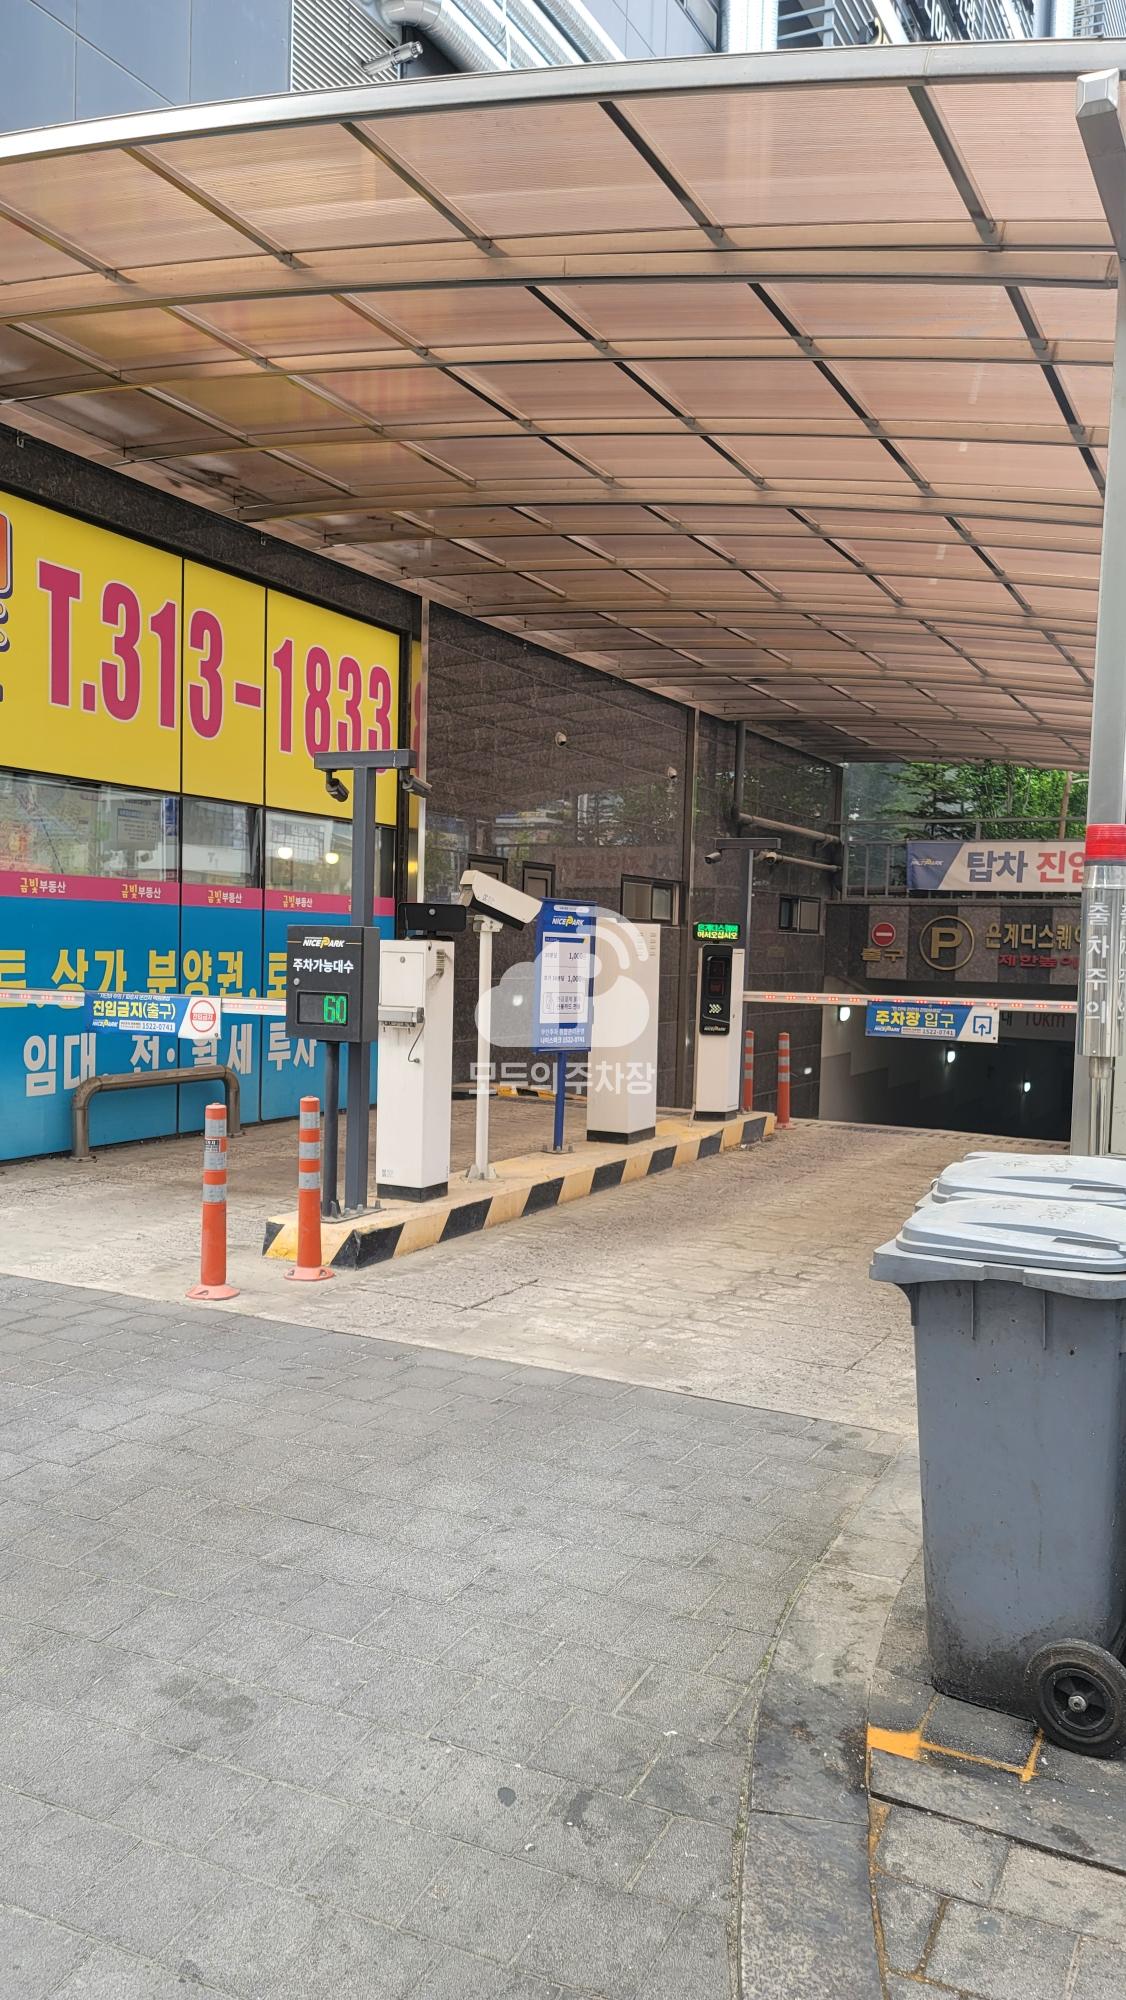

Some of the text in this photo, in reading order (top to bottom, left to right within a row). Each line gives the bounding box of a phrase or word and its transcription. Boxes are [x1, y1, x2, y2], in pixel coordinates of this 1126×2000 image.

[37, 558, 393, 774] T.313-1833
[967, 849, 1029, 884] 탑차
[20, 877, 66, 894] 금빛부동산
[121, 884, 162, 899] 금빛부동산
[207, 890, 242, 905] 금빛부동산
[283, 895, 313, 909] 금빛부동산
[552, 915, 585, 927] NICEPARK
[302, 936, 345, 949] NICEPARK
[697, 931, 739, 940] 어서오십시오
[930, 926, 963, 960] P
[292, 957, 355, 974] 주차가능대수
[92, 1000, 177, 1020] 진입금지(출구)
[323, 995, 347, 1025] 60
[141, 1023, 174, 1032] 1522-0741
[875, 1010, 955, 1029] 주차장 입구
[922, 1028, 954, 1036] 1522-0741
